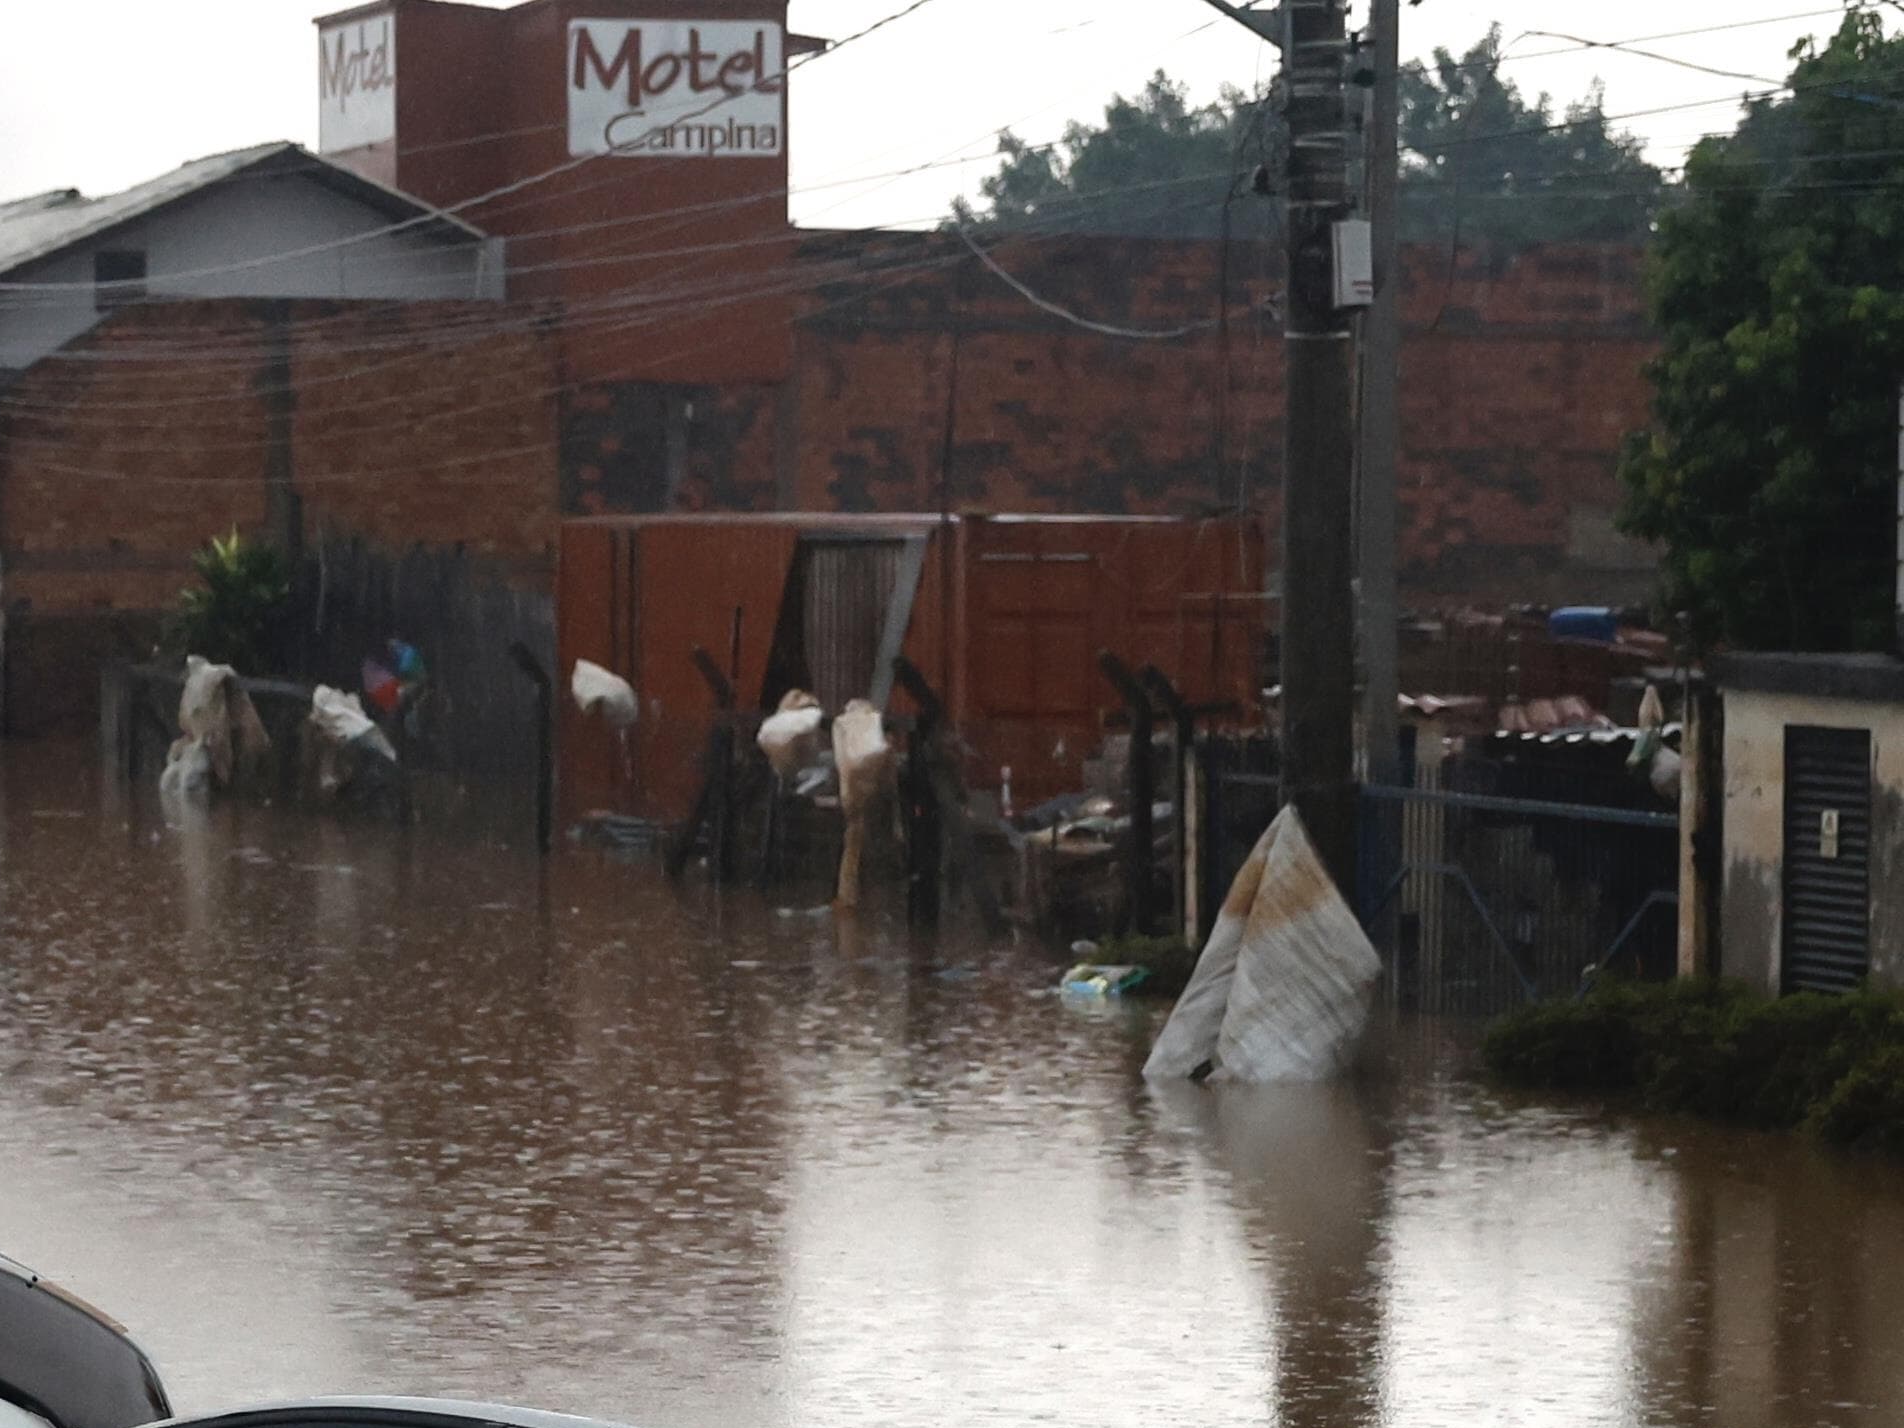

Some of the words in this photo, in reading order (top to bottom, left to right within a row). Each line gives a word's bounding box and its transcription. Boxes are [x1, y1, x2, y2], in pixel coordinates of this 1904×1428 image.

[322, 22, 394, 113] Motel
[573, 28, 781, 107] Motel
[605, 110, 779, 156] Campina
